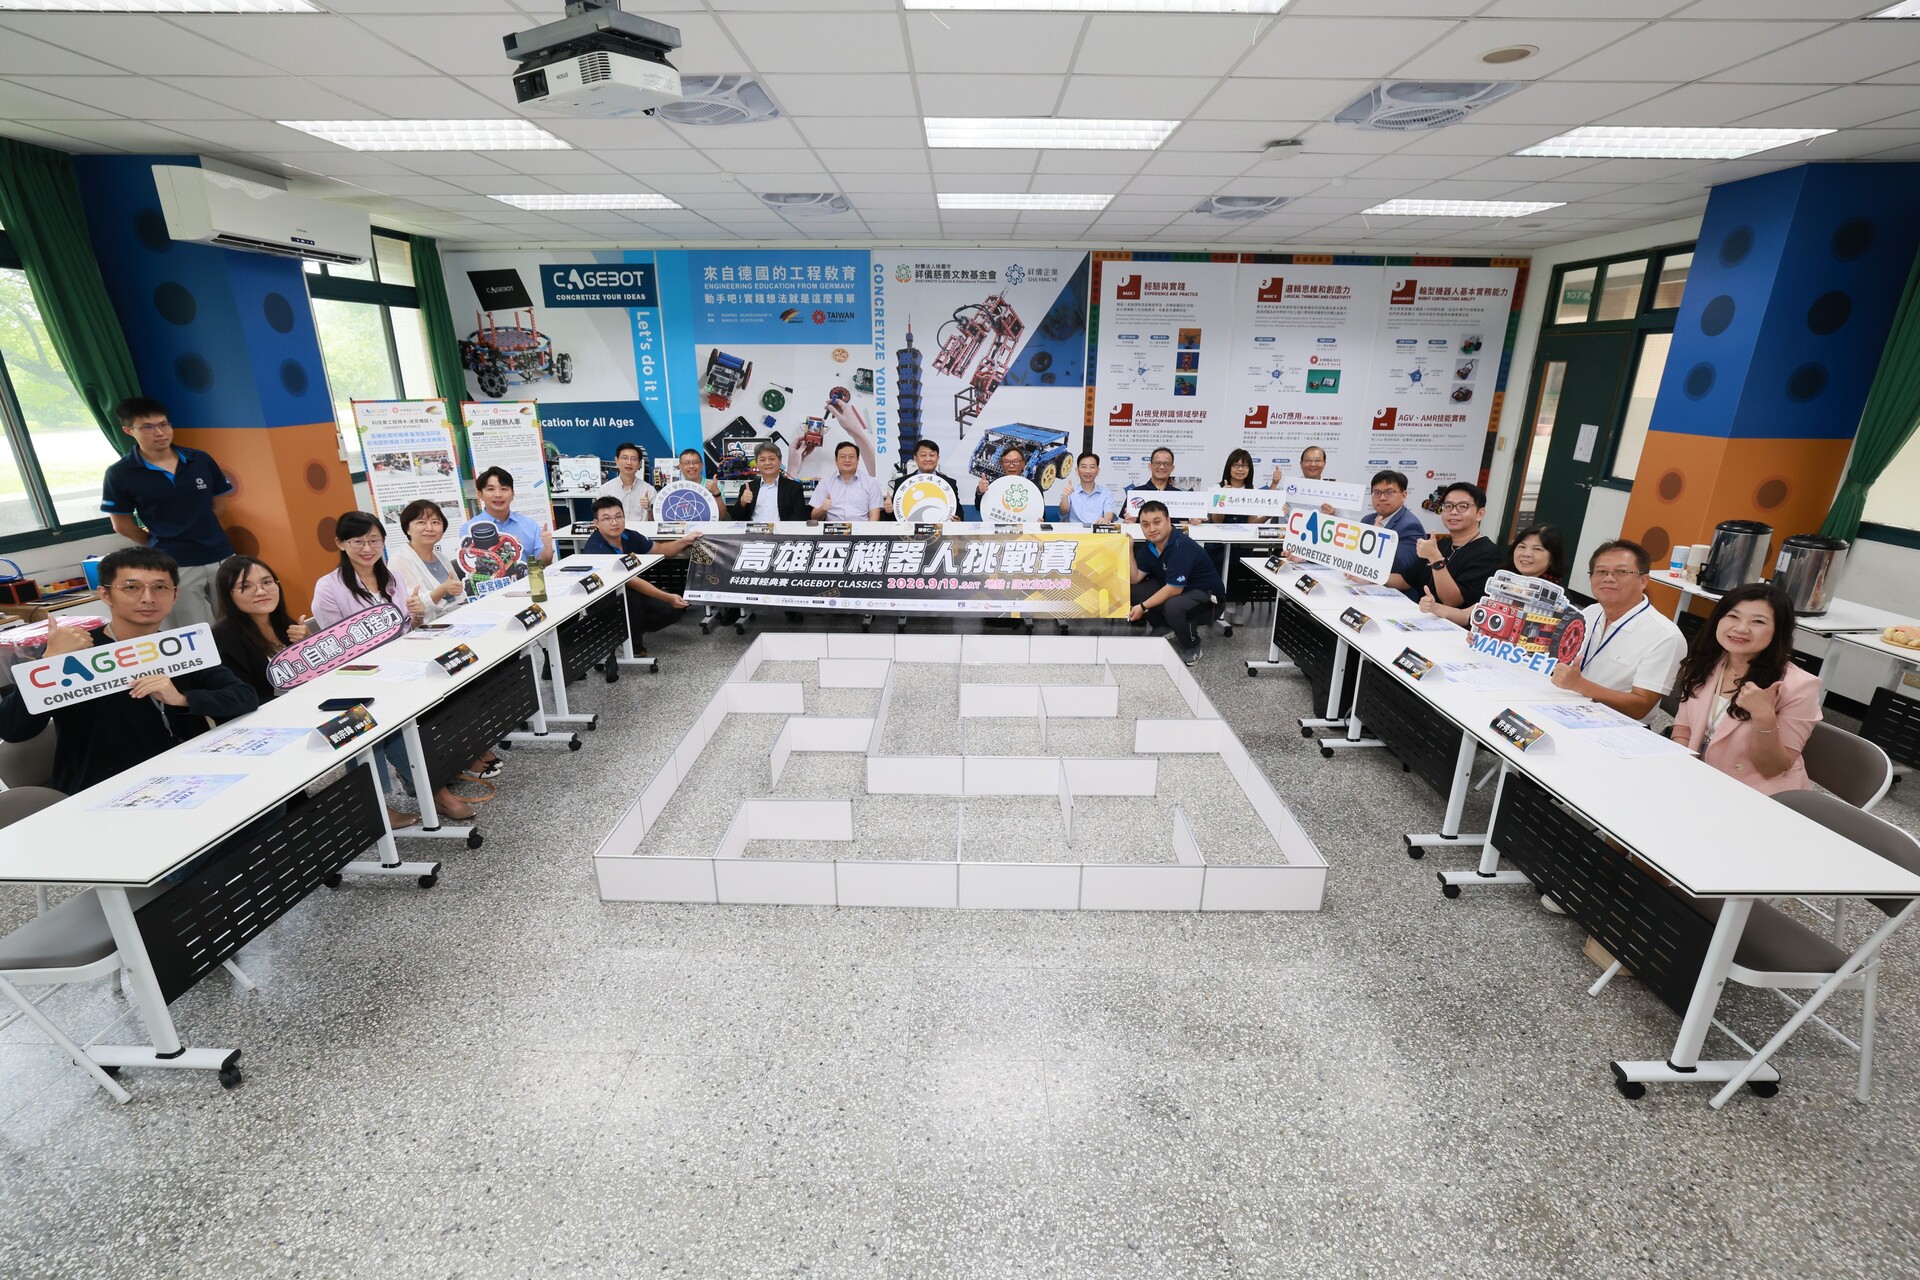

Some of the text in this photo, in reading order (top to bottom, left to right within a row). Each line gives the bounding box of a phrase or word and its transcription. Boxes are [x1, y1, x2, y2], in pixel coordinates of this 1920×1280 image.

[553, 268, 645, 290] CAGEBOT
[704, 265, 856, 281] 來自德國的工程教育
[915, 270, 997, 280] 祥儀慈善文教基金會
[486, 285, 514, 293] CAGEBOT
[1144, 282, 1185, 291] 經驗與實踐
[1285, 285, 1351, 294] 邏輯思維和創造力
[1419, 287, 1508, 297] 輪型機器人基本實務能力
[641, 355, 655, 376] do
[874, 263, 888, 454] CONCRETIZE YOUR IDEAS
[644, 380, 657, 392] it
[575, 417, 589, 427] for
[592, 417, 606, 427] All
[609, 418, 634, 428] Ages
[1289, 511, 1390, 559] CAGEBOT
[733, 541, 1077, 575] 高雄盃機器人挑戰賽
[1286, 542, 1379, 580] CONCRETIZE YOUR IDEAS
[729, 576, 789, 587] 科技寶經典賽
[791, 578, 836, 588] CAGEBOT
[837, 580, 883, 589] CLASSICS
[29, 631, 197, 688] CAGEBOT
[1469, 633, 1558, 675] MARS-E1
[43, 676, 128, 706] CONCRETIZE
[168, 657, 204, 673] IDEAS
